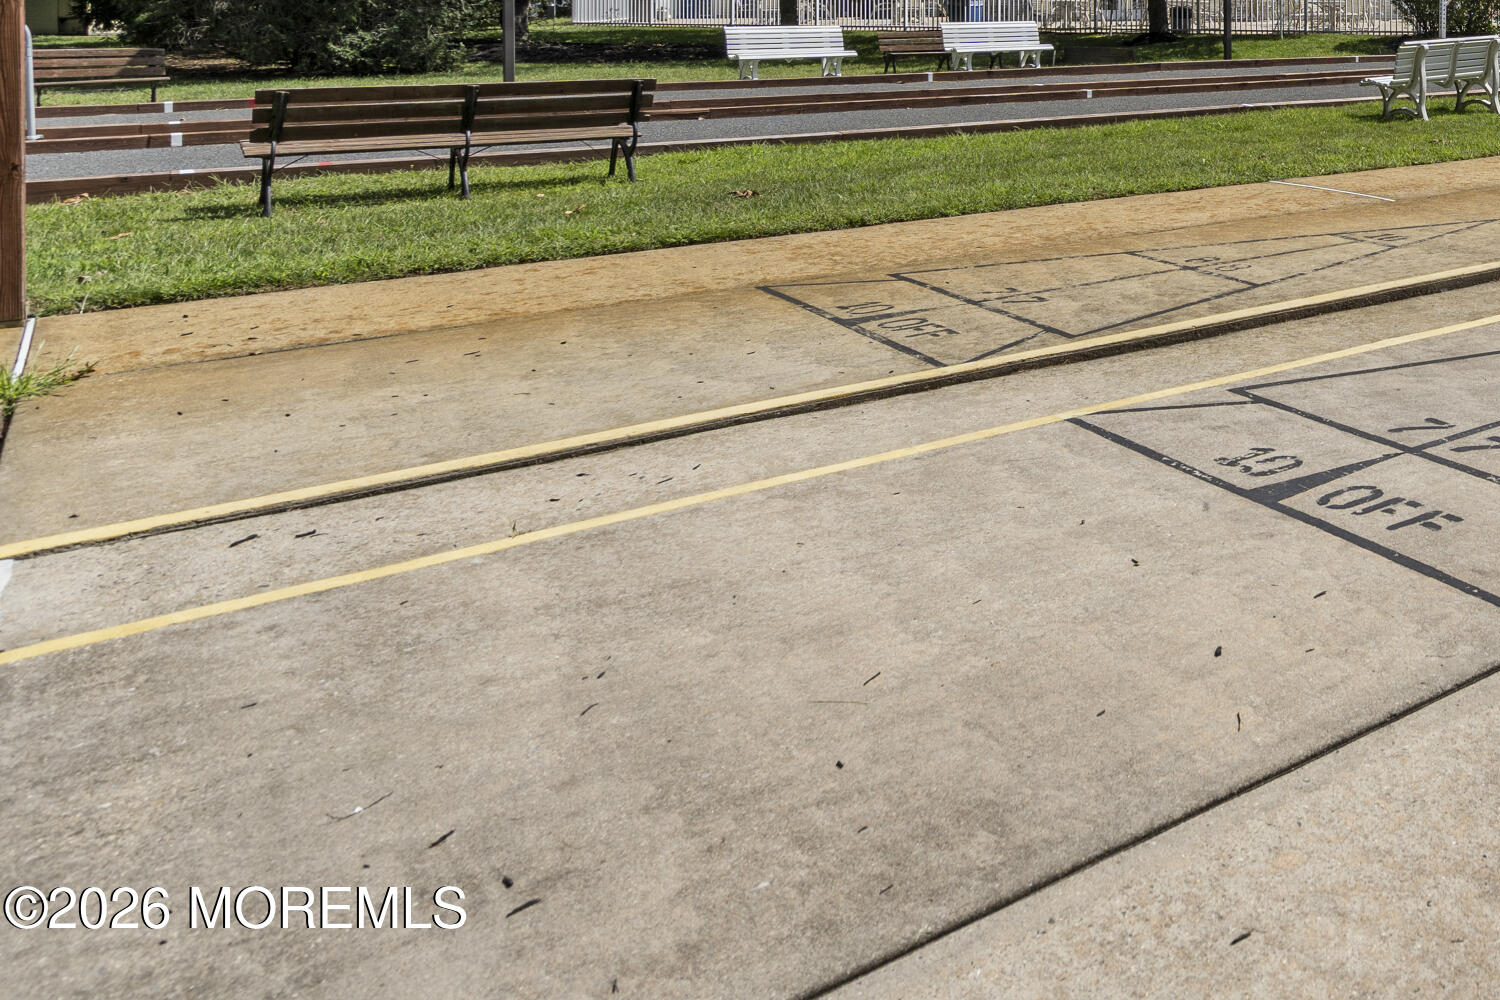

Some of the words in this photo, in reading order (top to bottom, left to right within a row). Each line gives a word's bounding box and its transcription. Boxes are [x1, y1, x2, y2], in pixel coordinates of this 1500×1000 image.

[836, 301, 894, 315] 10
[877, 318, 960, 338] OFF
[1387, 417, 1456, 433] 7
[1213, 447, 1304, 477] 10
[1316, 485, 1464, 531] OFF
